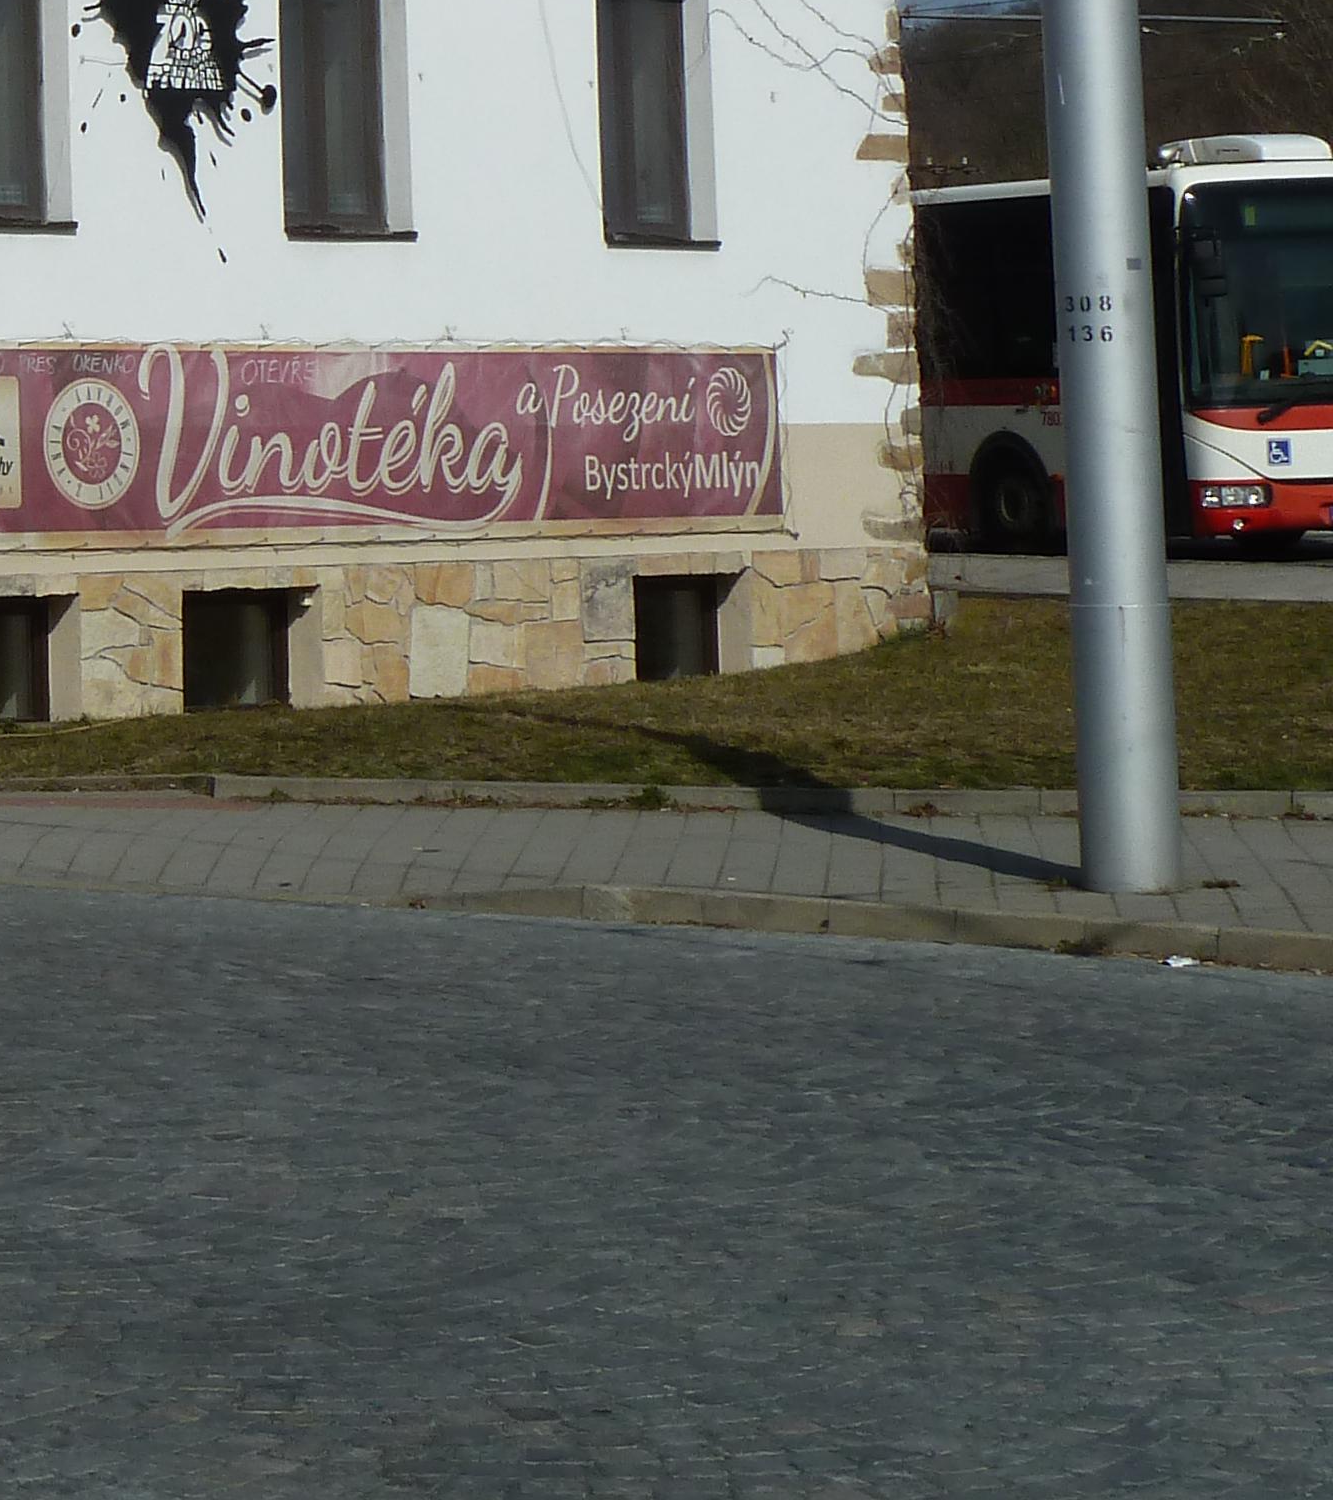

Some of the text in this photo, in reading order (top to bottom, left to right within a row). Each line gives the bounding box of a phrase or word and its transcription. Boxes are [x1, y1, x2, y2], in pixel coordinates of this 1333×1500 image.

[1064, 295, 1112, 312] 308
[1068, 324, 1113, 342] 136
[516, 364, 696, 442] a Posezení
[138, 343, 521, 536] Vinotéka
[584, 451, 763, 500] BystrckýMlýn
